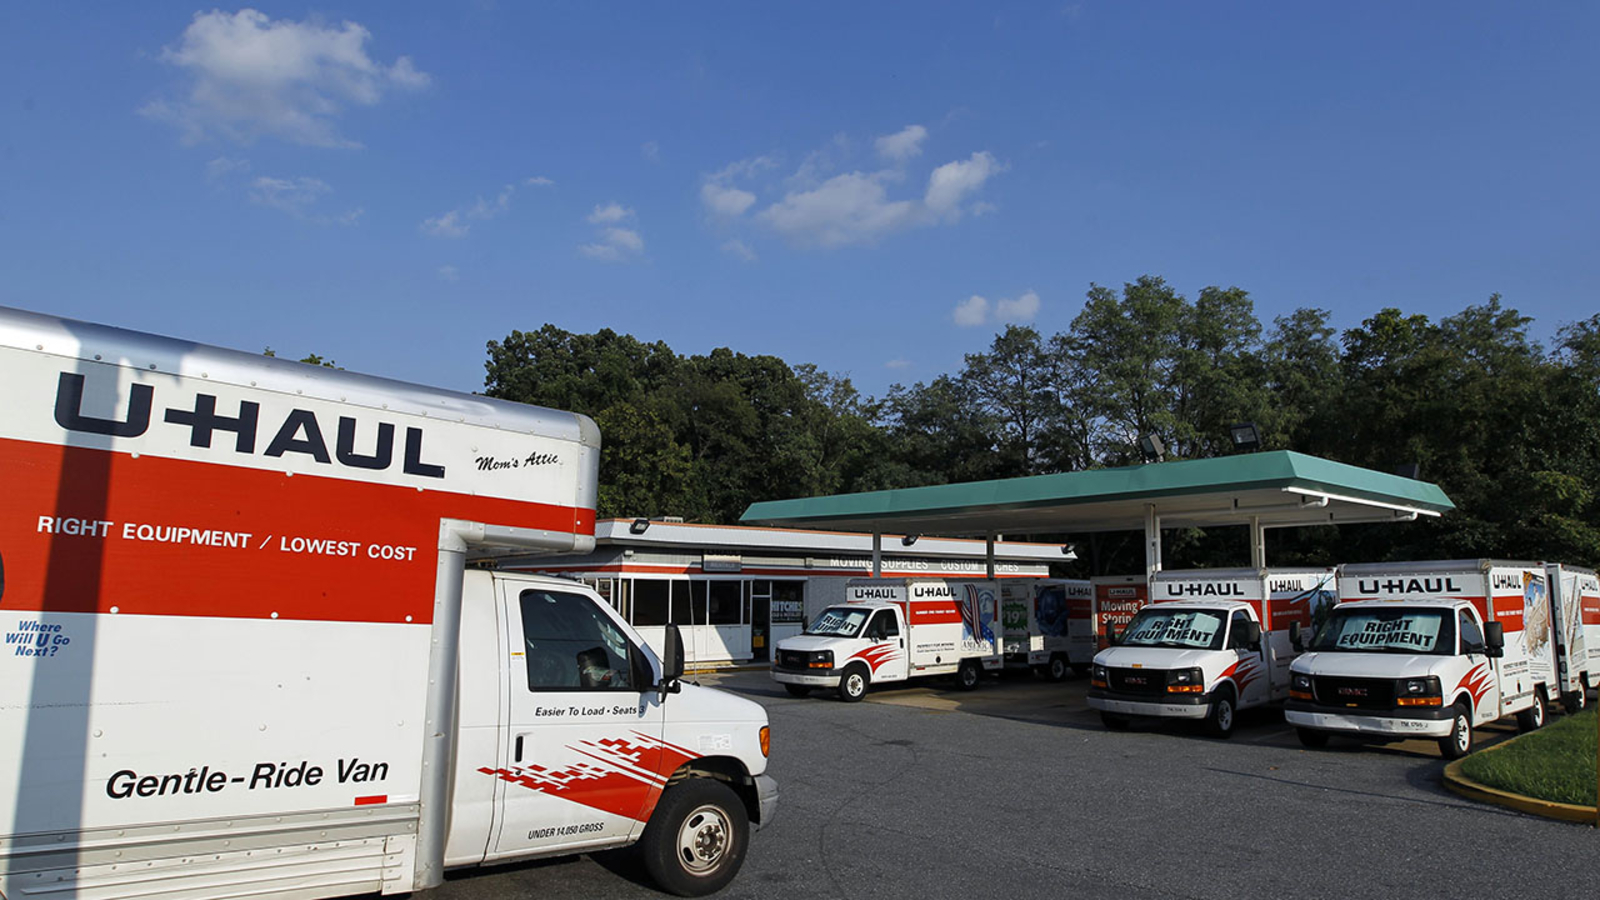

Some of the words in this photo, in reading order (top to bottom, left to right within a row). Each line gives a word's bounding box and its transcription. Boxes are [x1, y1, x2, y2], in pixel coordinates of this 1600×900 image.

[54, 371, 446, 479] U-HAUL
[475, 456, 519, 471] Mom's
[523, 451, 559, 467] Attic
[37, 515, 114, 538] RIGHT
[122, 523, 252, 548] EQUIPMENT
[280, 536, 360, 557] LOWEST
[367, 544, 416, 561] COST
[829, 556, 873, 567] MOVING
[881, 558, 929, 570] SUPPLIES
[940, 560, 978, 571] CUSTOM
[984, 561, 1020, 572] CHES
[914, 587, 957, 598] U-HAUL
[1068, 588, 1091, 596] U-HA
[1168, 583, 1245, 596] U-HAUL
[1270, 580, 1304, 592] U-HAUL
[1359, 578, 1461, 593] U-HAUL
[855, 589, 897, 599] U-HAUL
[1101, 600, 1144, 614] Moving?
[1102, 613, 1132, 624] Storin
[19, 620, 62, 632] Where
[1364, 620, 1413, 634] RIGHT
[5, 633, 34, 644] Will
[36, 633, 51, 647] U
[52, 634, 70, 645] Go
[1340, 631, 1434, 647] EQUIPMENT
[15, 645, 59, 657] Next?
[535, 706, 566, 717] Easier
[568, 706, 579, 716] To
[581, 706, 606, 716] Load
[612, 705, 637, 715] Seats
[639, 705, 646, 714] 3
[106, 761, 323, 799] Gentle-Ride
[337, 758, 389, 784] Van
[528, 828, 555, 840] UNDER
[556, 825, 579, 836] 14,050
[579, 822, 604, 834] GROSS
